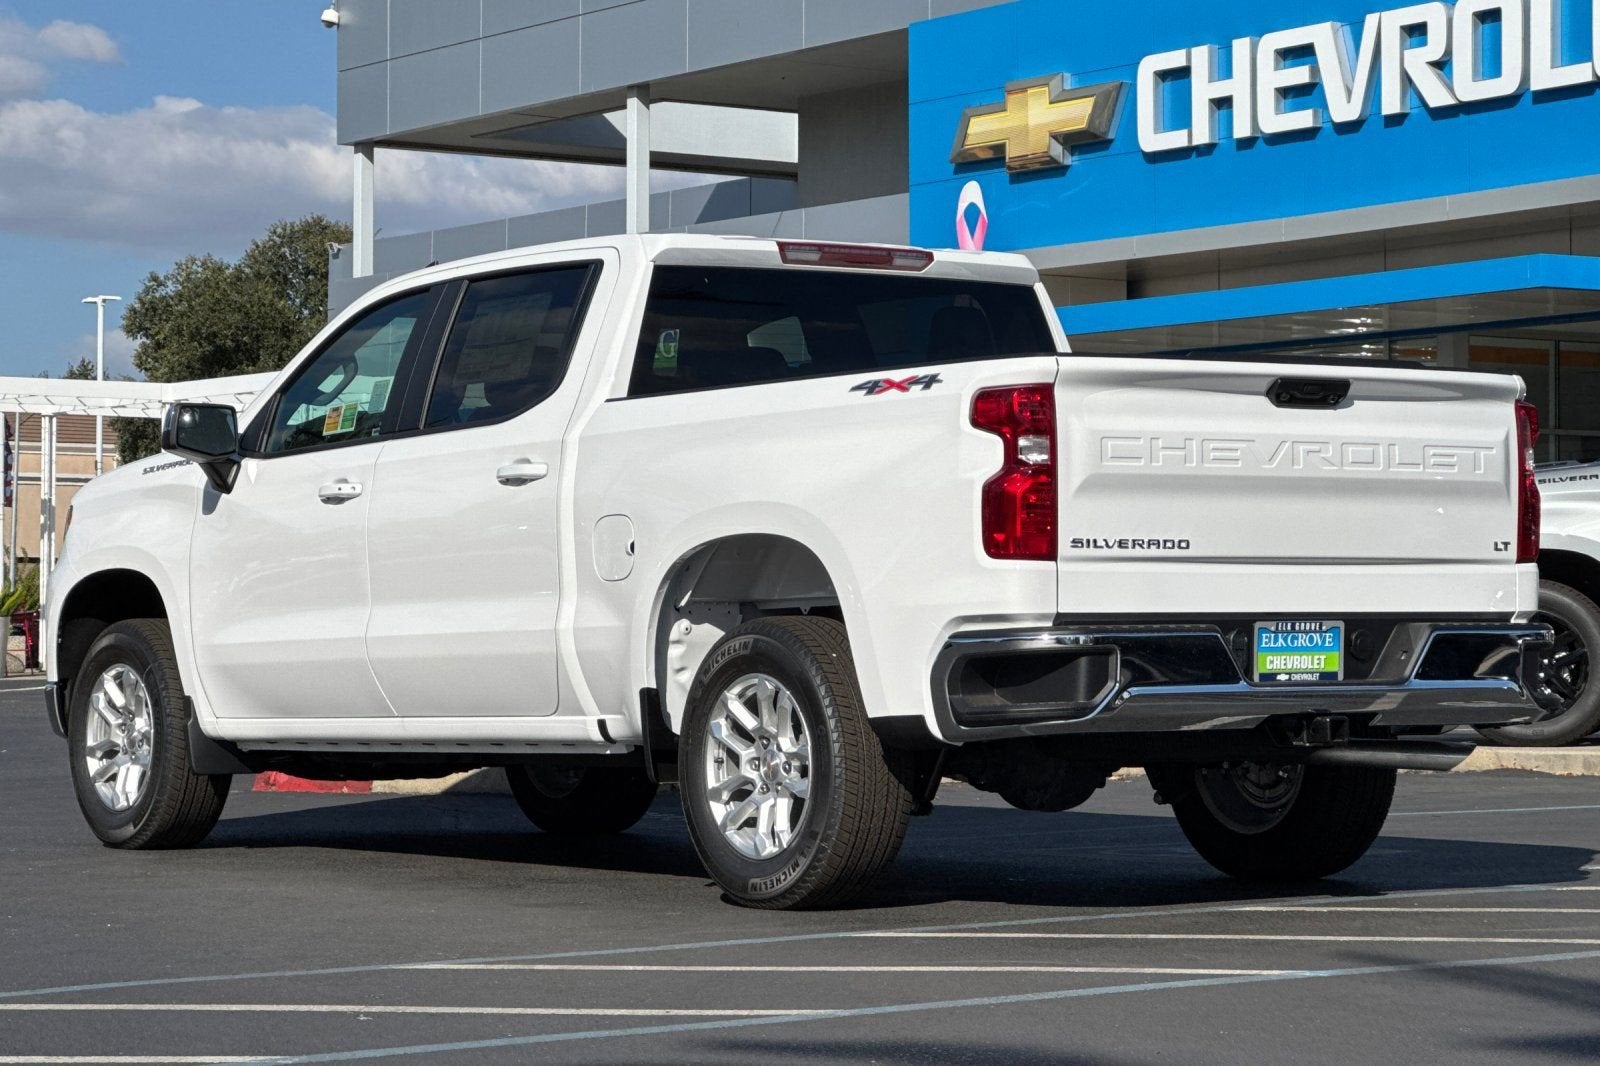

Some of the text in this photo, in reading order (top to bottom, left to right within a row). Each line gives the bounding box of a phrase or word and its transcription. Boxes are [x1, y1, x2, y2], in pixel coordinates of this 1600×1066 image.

[1137, 0, 1600, 153] CHEVROL
[1100, 436, 1497, 474] CHEVROLET
[1070, 538, 1190, 550] SILVERADO
[1493, 541, 1511, 551] LT
[1278, 622, 1320, 631] ELK GROVE
[703, 640, 751, 680] MICHELIN
[1266, 655, 1327, 670] CHEVROLET
[1290, 673, 1320, 681] CHEVROLET
[749, 858, 801, 893] MICHELIN
